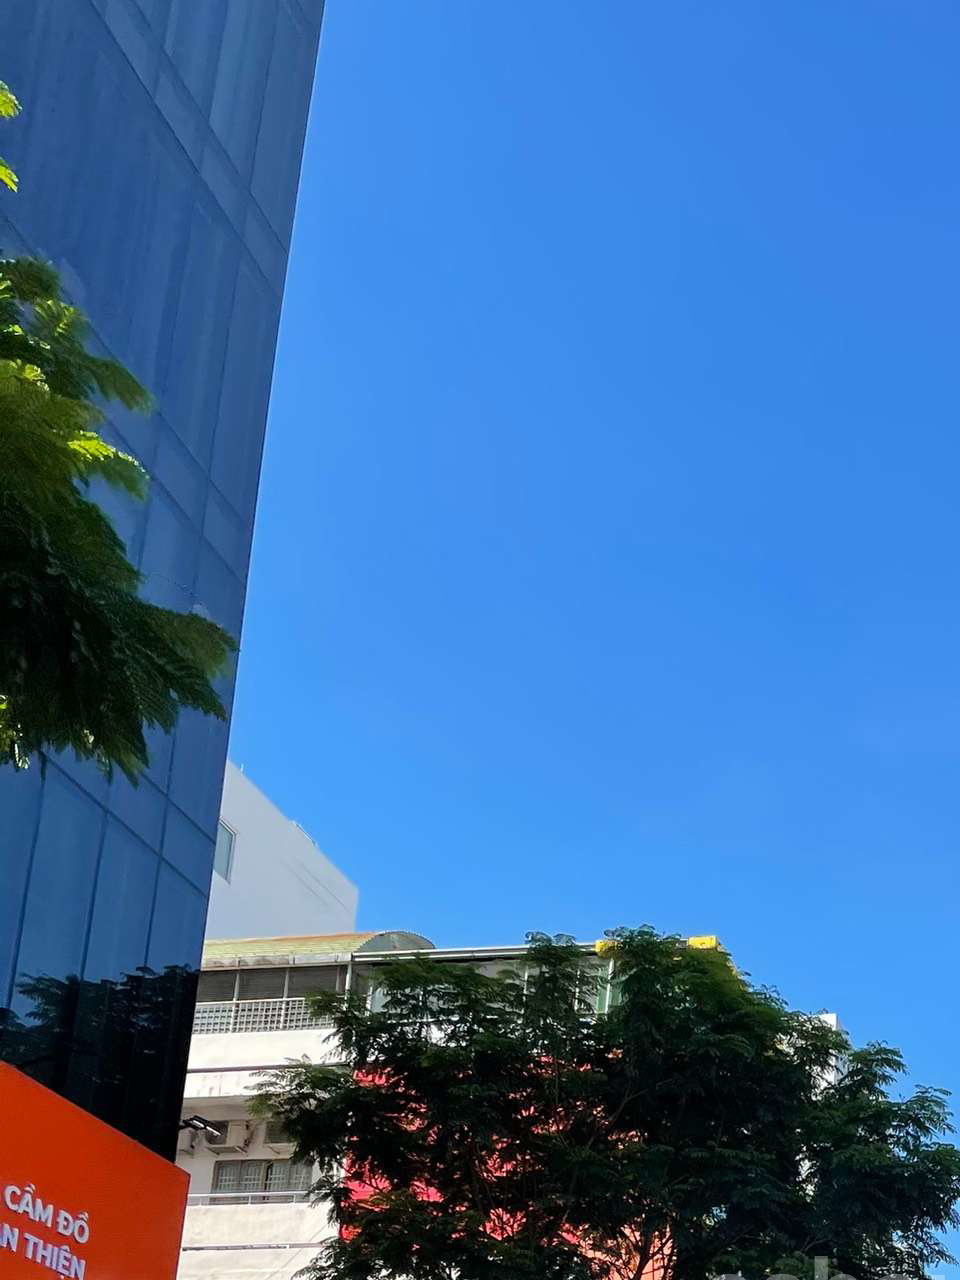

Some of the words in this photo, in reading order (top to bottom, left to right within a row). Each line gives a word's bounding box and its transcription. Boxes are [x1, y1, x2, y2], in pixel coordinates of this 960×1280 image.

[4, 1183, 54, 1228] CẦM
[55, 1211, 90, 1244] ĐỒ
[0, 1223, 19, 1253] N
